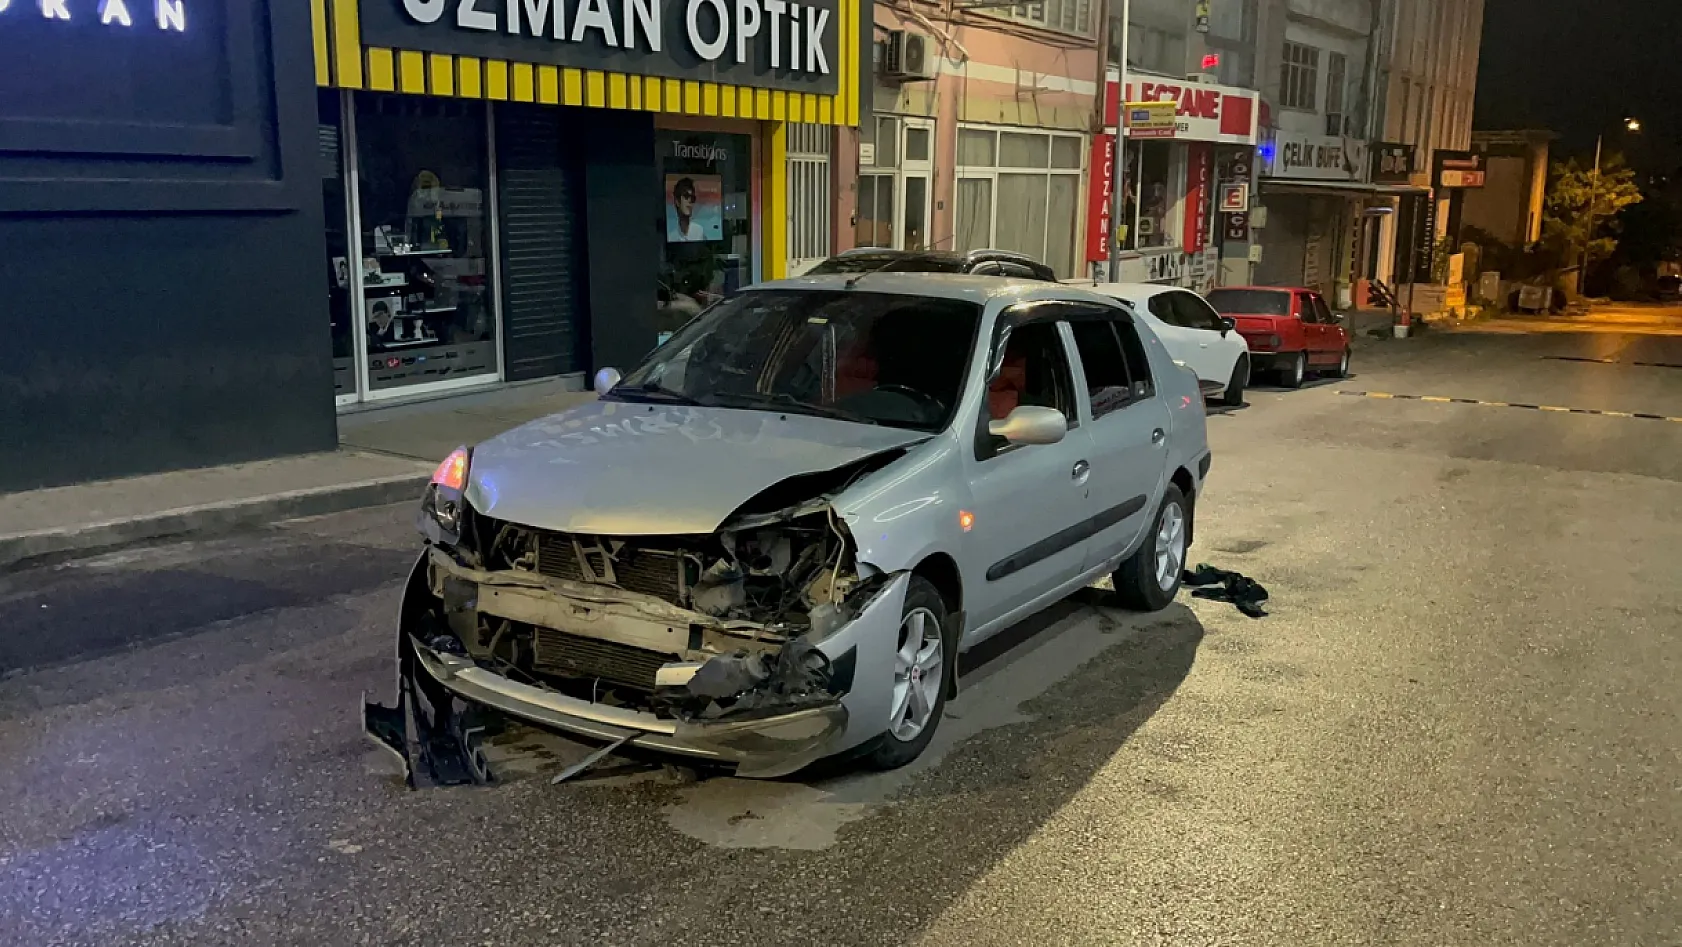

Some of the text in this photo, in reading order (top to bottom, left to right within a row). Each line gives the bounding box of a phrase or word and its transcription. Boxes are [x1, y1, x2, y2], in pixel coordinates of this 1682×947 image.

[404, 0, 661, 52] MAN
[1142, 82, 1221, 119] ECZANE
[672, 140, 727, 165] Transitions
[1100, 141, 1114, 252] ECZANE
[1227, 188, 1240, 206] E
